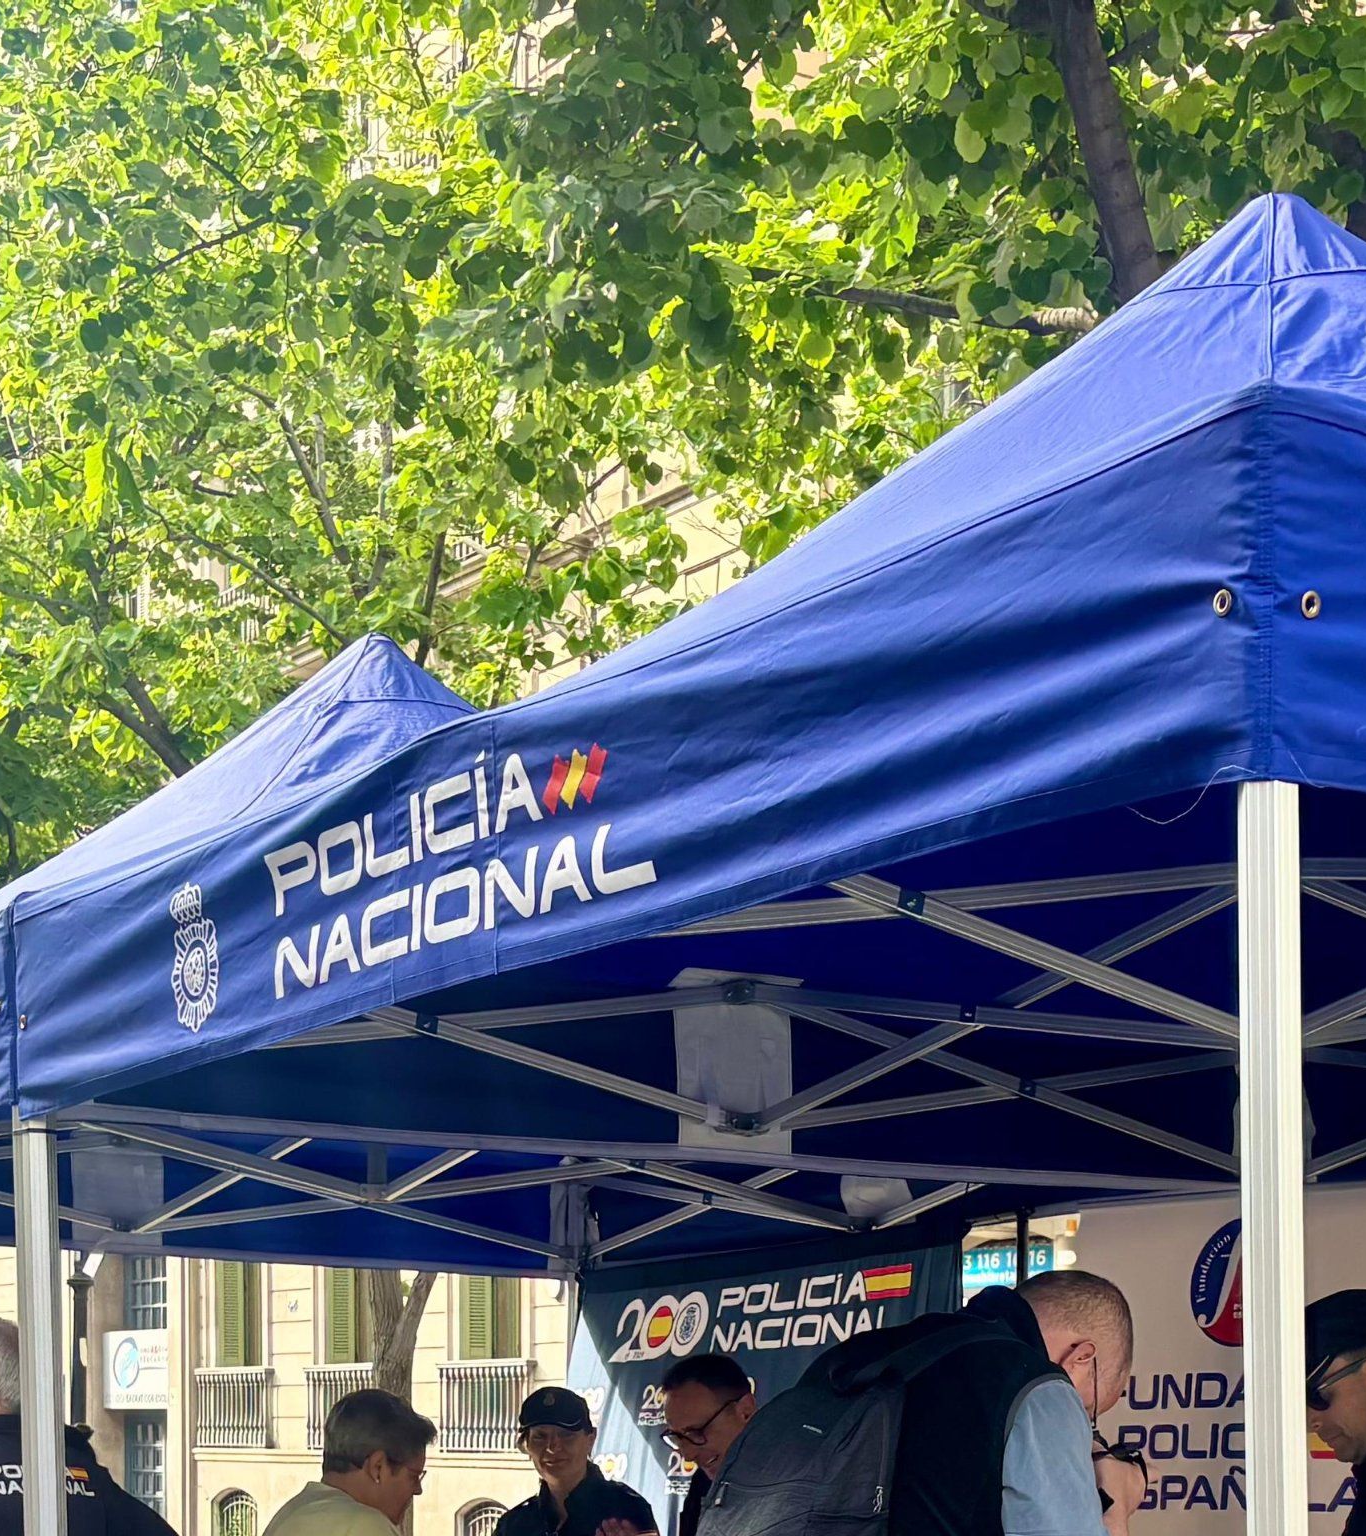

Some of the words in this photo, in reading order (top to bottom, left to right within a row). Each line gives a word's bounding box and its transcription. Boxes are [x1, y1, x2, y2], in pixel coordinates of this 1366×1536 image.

[263, 750, 542, 916] POLICÍA
[274, 823, 656, 1000] NACIONAL
[977, 1252, 1000, 1269] 116
[609, 1291, 709, 1363] 200
